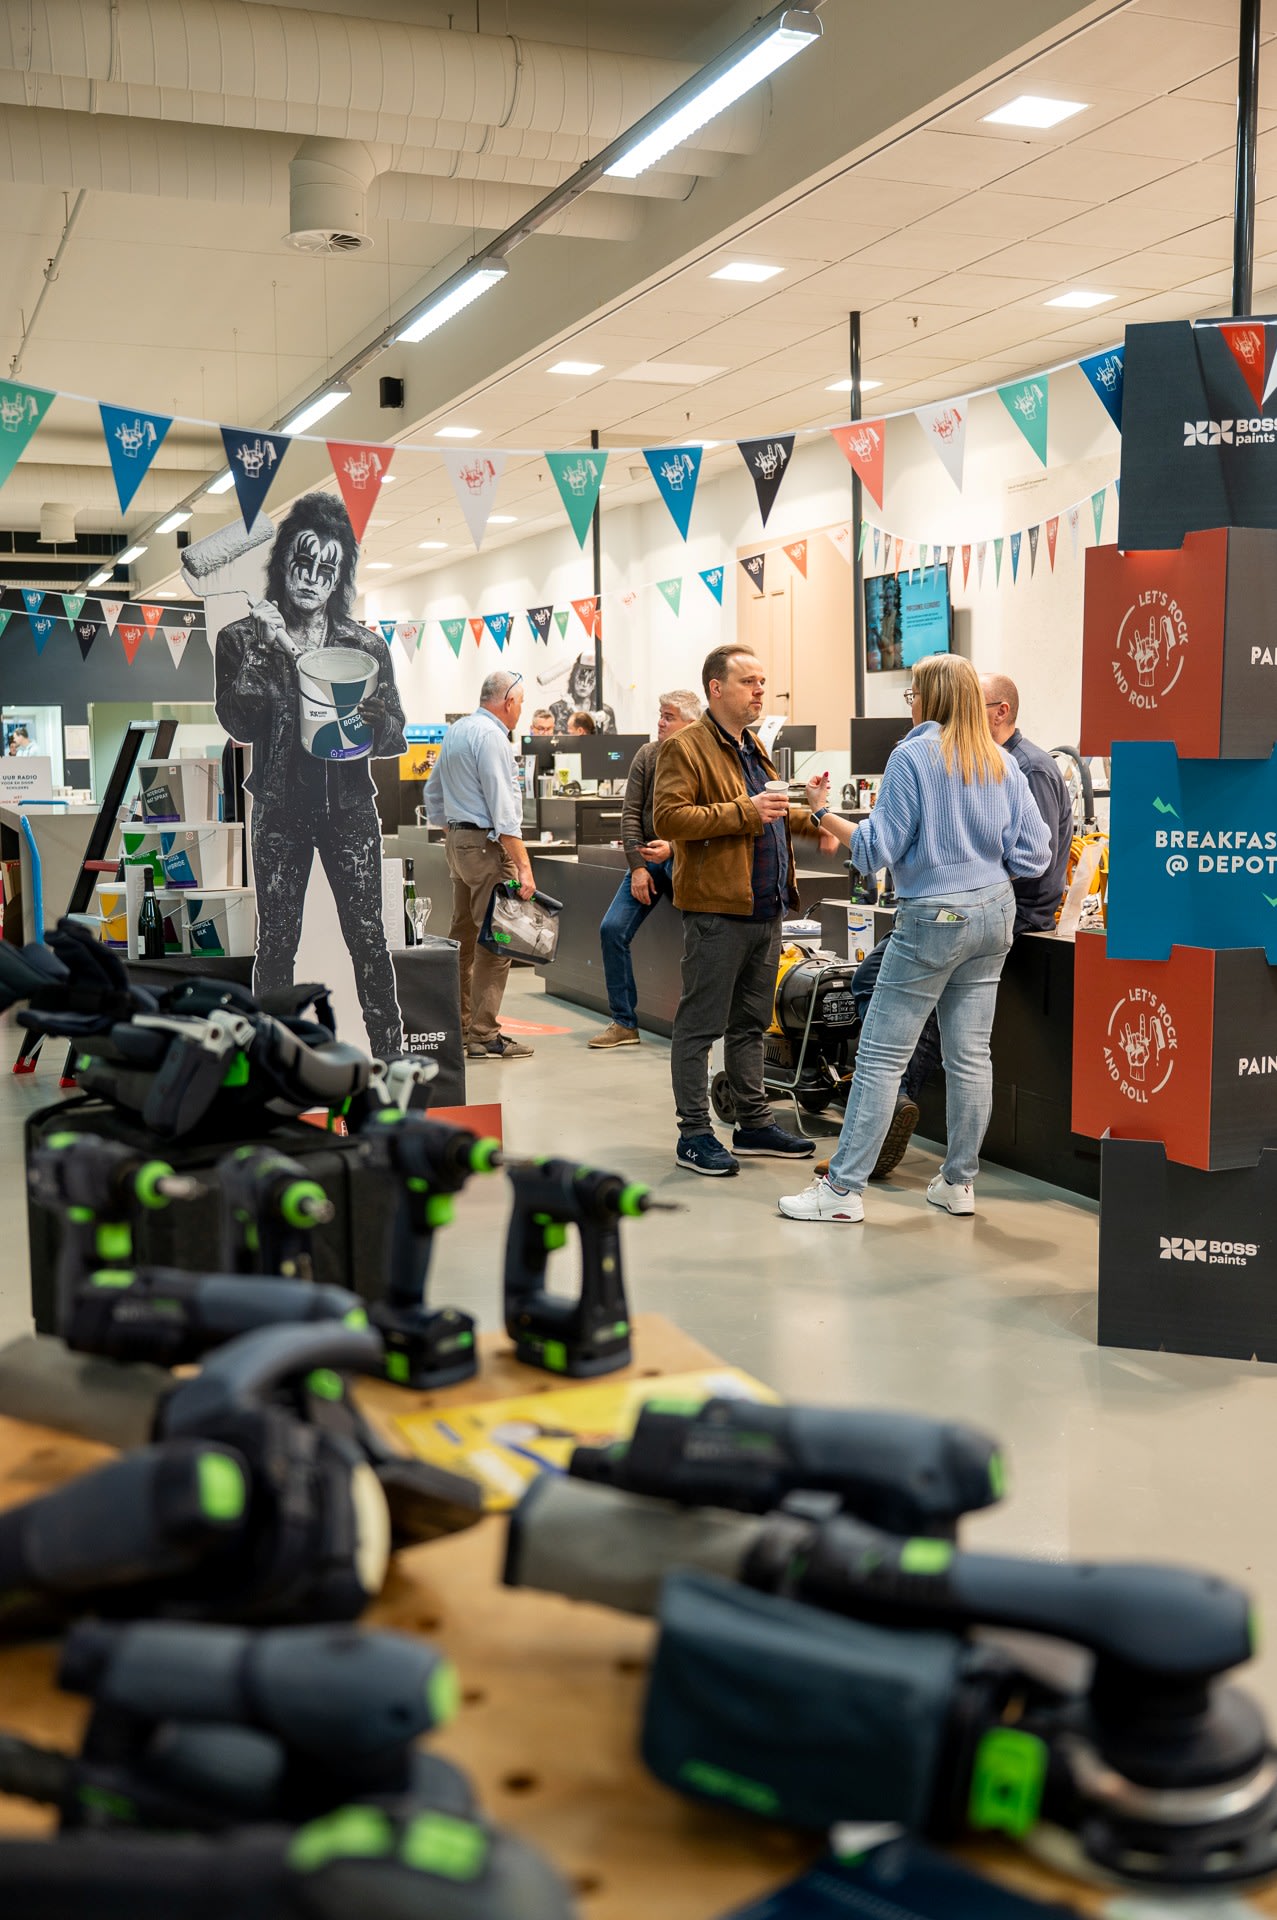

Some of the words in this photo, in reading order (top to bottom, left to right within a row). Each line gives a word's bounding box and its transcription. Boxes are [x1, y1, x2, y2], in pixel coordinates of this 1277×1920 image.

[1235, 432, 1275, 447] paints
[1138, 590, 1168, 607] LET'S
[1167, 600, 1189, 646] ROCK
[1111, 661, 1129, 694] AND
[1128, 690, 1158, 709] ROLL
[353, 721, 363, 731] MA
[1155, 830, 1277, 850] BREAKFAS
[1165, 854, 1188, 877] @
[1198, 855, 1277, 874] DEPOT
[1129, 988, 1157, 1007] LET'S
[1157, 1003, 1178, 1049] ROCK
[410, 1031, 446, 1043] BOSS
[410, 1042, 439, 1053] paints
[1103, 1047, 1120, 1081] AND
[1119, 1080, 1149, 1103] ROLL
[1238, 1056, 1277, 1076] PAIN
[1209, 1240, 1257, 1256] BOSS
[1209, 1254, 1247, 1266] paints
